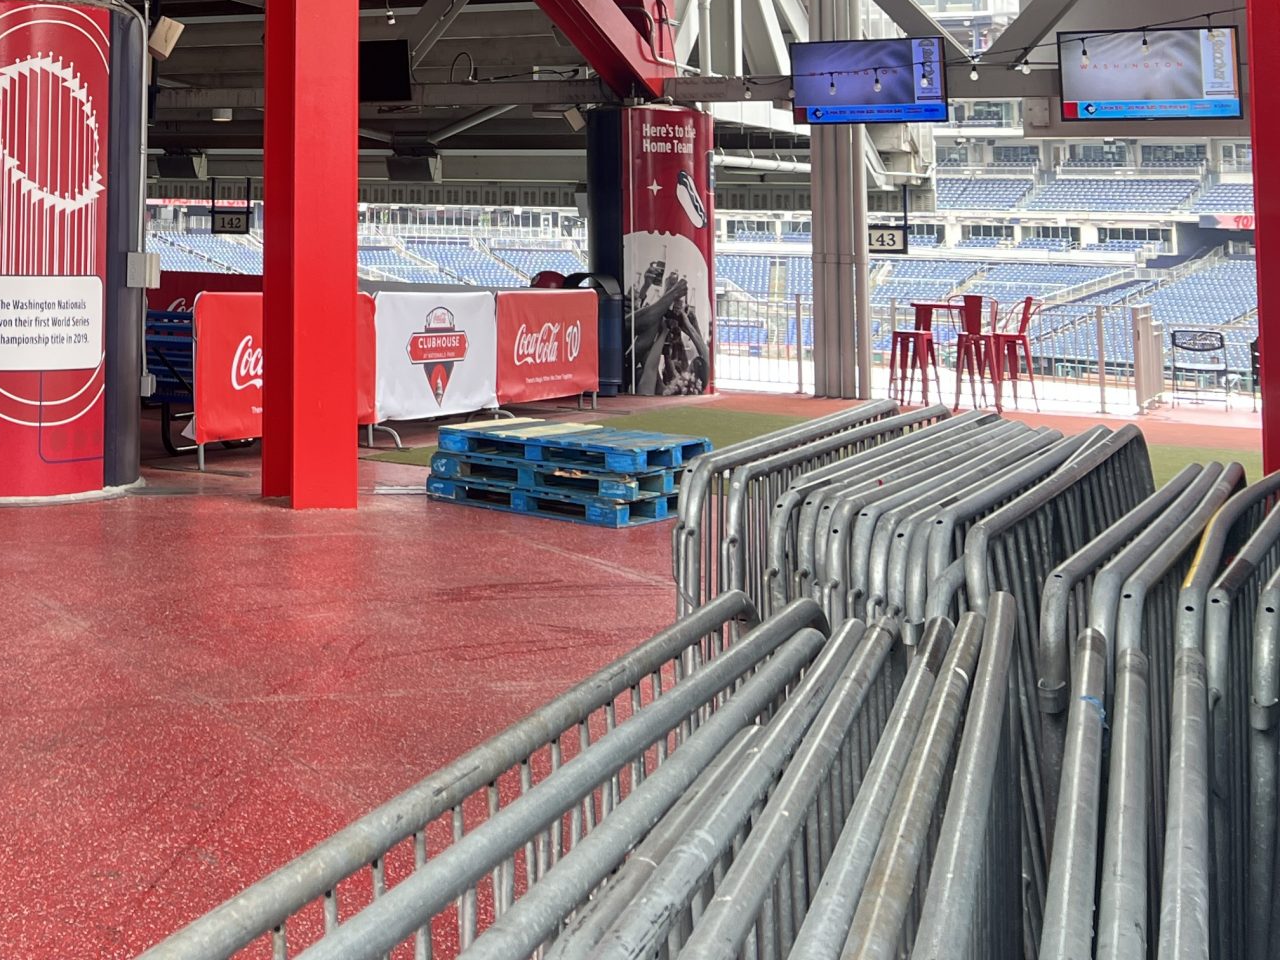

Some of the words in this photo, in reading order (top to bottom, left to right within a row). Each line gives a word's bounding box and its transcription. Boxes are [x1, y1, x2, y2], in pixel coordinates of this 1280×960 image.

[1080, 62, 1184, 71] WASHINGTON
[642, 124, 673, 138] Here's
[675, 125, 684, 138] to
[685, 125, 696, 139] the
[643, 139, 672, 153] Home
[673, 140, 693, 154] Team
[221, 217, 241, 229] 142
[868, 232, 896, 247] 143
[13, 299, 56, 312] Washington
[57, 299, 86, 310] Nationals
[14, 317, 33, 327] their
[34, 317, 50, 327] first
[51, 317, 70, 327] World
[71, 317, 90, 327] Series
[50, 333, 65, 344] title
[66, 333, 73, 344] in
[73, 333, 90, 344] 2019.
[418, 336, 460, 349] CLUBHOUSE
[514, 322, 561, 366] Coca-Cola
[566, 320, 581, 362] W
